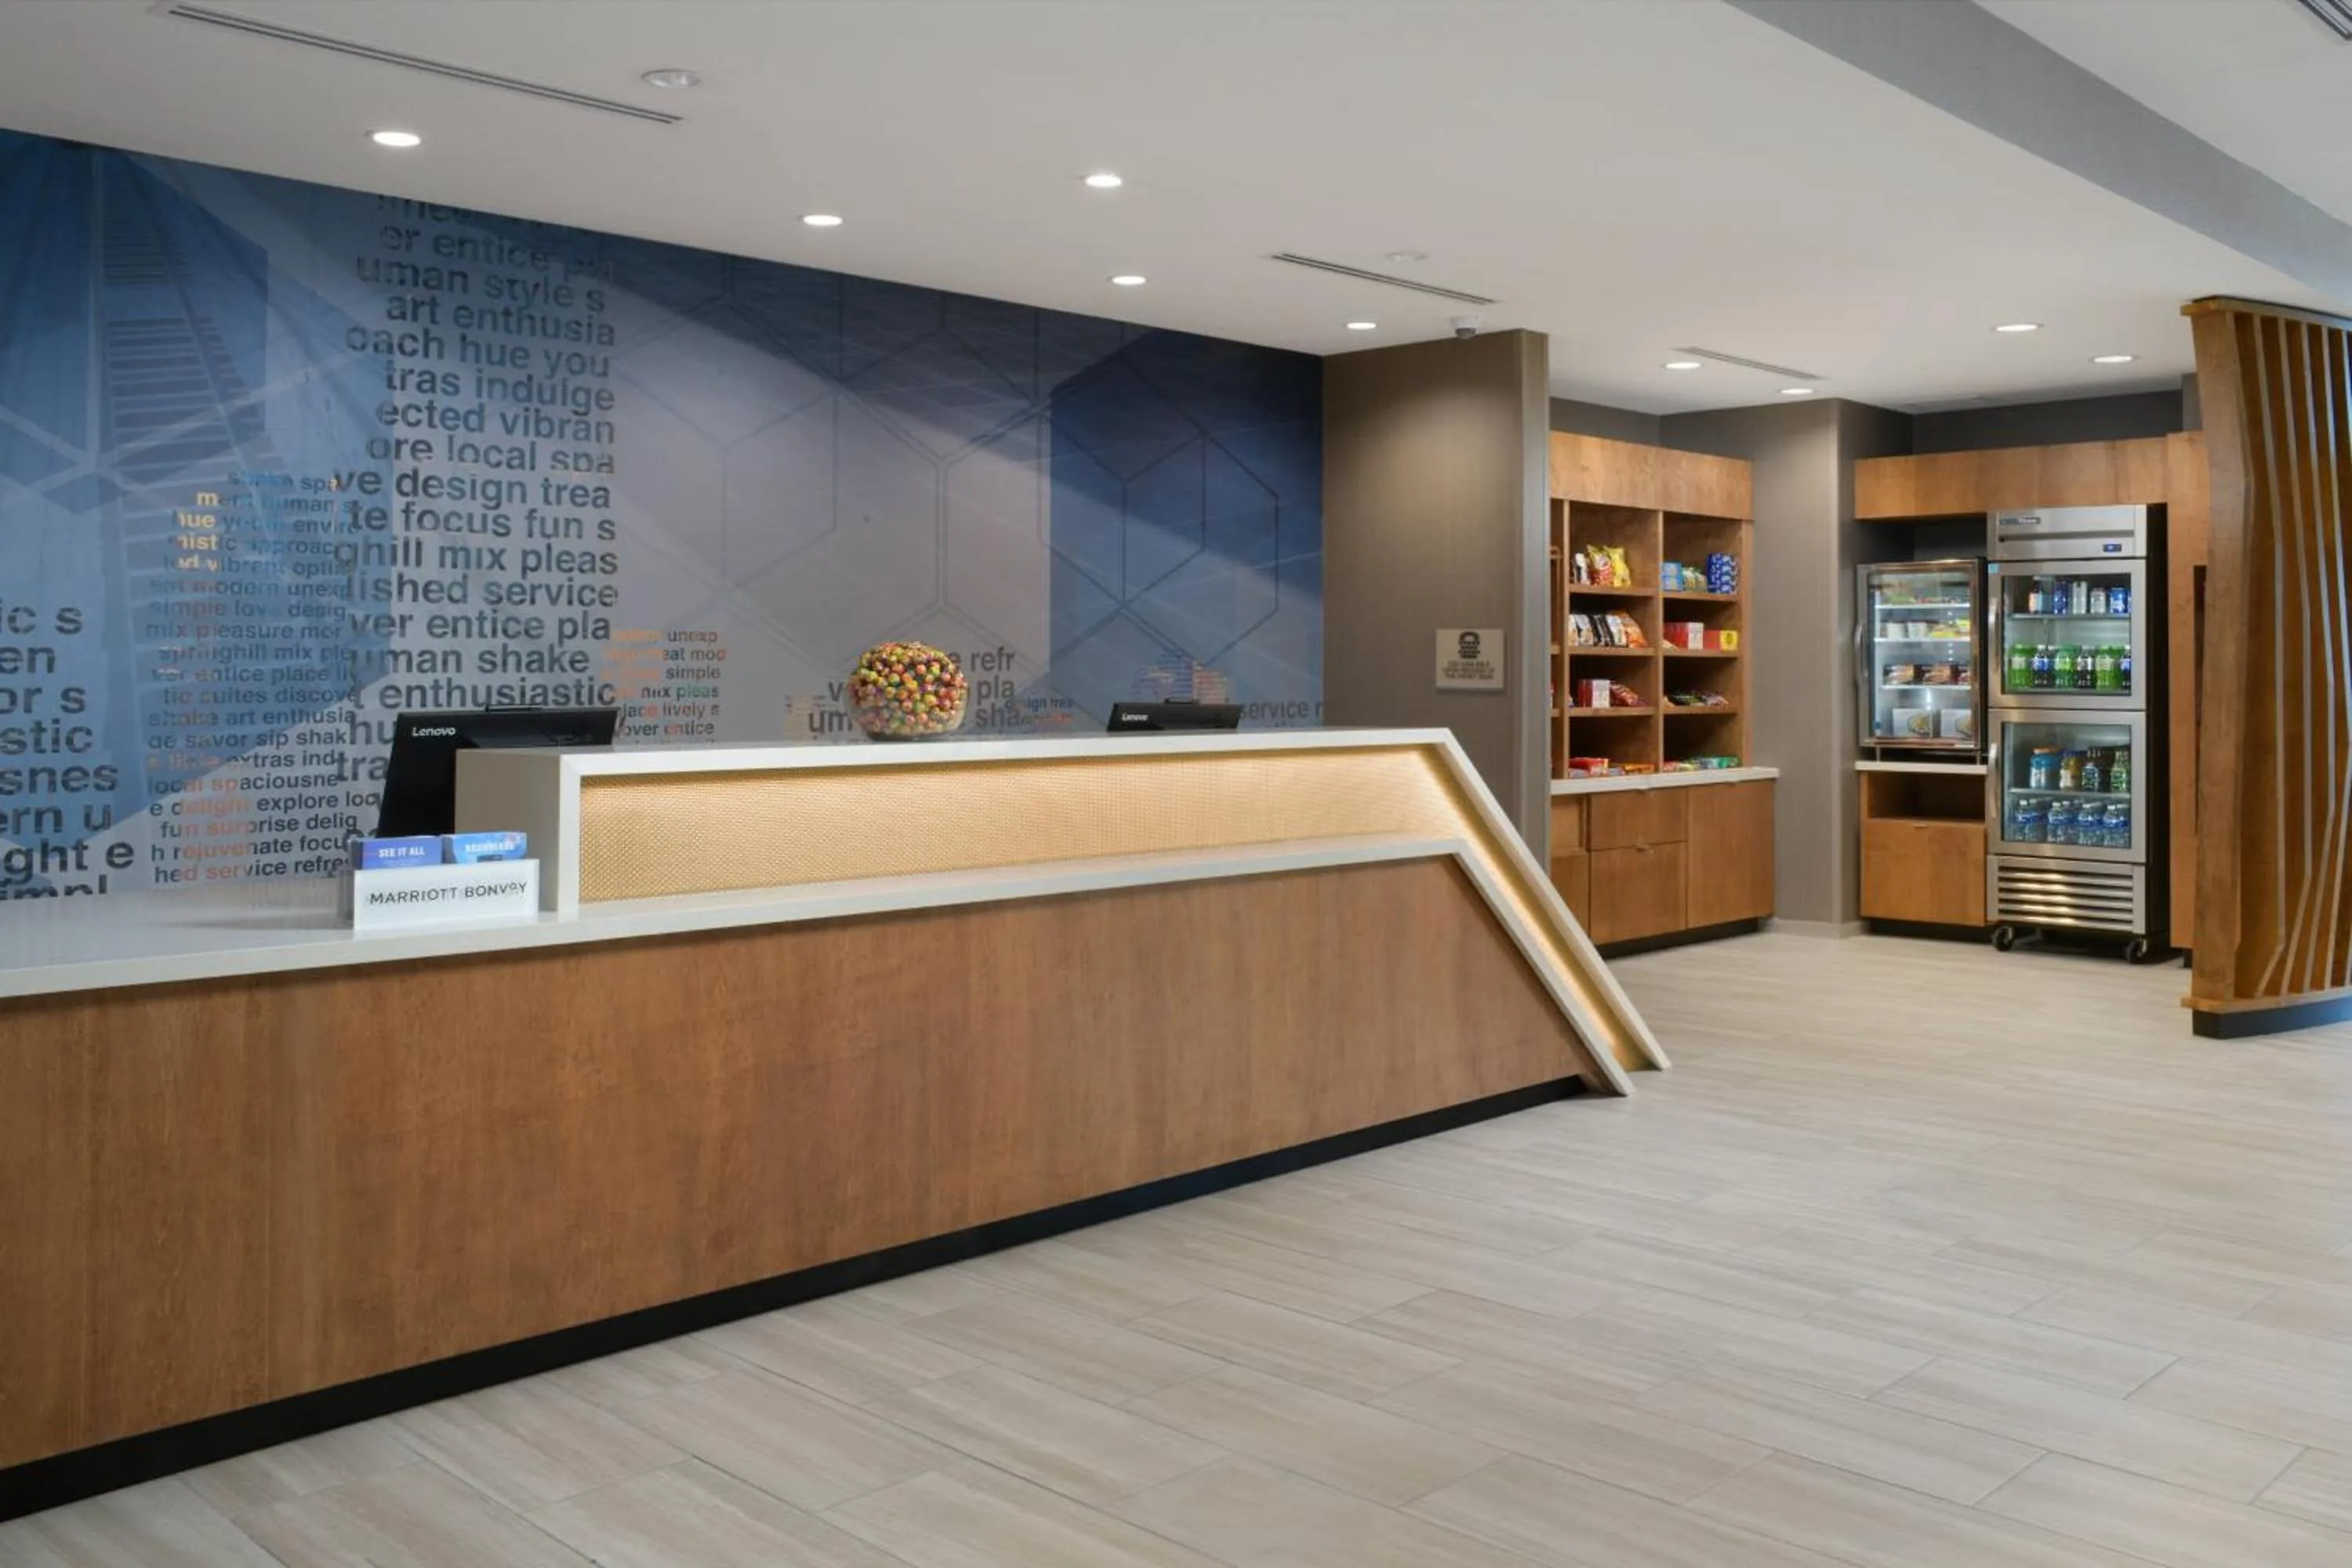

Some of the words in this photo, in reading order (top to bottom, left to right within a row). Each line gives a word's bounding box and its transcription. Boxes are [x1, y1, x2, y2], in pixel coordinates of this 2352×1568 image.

[433, 232, 552, 272] entice
[356, 255, 469, 294] uman
[483, 274, 575, 310] style
[586, 288, 607, 313] s
[387, 294, 440, 325] art
[453, 303, 615, 347] enthusia
[346, 326, 445, 360] oach
[459, 332, 531, 369] hue
[543, 350, 609, 379] you
[385, 359, 461, 397] tras
[475, 369, 615, 416] indulge
[376, 397, 486, 433] ected
[499, 406, 615, 444] vibran
[367, 437, 434, 461] ore
[447, 434, 537, 471] local
[550, 449, 615, 474] spa
[395, 467, 528, 510] design
[539, 477, 611, 509] trea
[401, 501, 512, 538] focus
[524, 509, 583, 539] fun
[597, 517, 616, 541] s
[437, 544, 507, 571] mix
[521, 543, 619, 580] pleas
[481, 576, 619, 608] service
[56, 606, 83, 635] s
[426, 608, 545, 641] entice
[557, 610, 612, 648] pla
[476, 643, 590, 675] shake
[970, 646, 1016, 673] refr
[60, 686, 87, 714] s
[379, 677, 616, 710] enthusiastic
[976, 674, 1015, 706] pla
[0, 718, 93, 754] stic
[256, 728, 289, 749] sip
[412, 727, 457, 738] Lenovo
[336, 751, 391, 782] tra
[83, 803, 112, 832] u
[149, 803, 164, 817] e
[256, 791, 339, 815] explore
[2, 838, 89, 886] ght
[105, 840, 135, 869] e
[378, 848, 396, 858] SEE
[397, 847, 408, 858] IT
[408, 845, 426, 856] ALL
[369, 886, 458, 905] MARRIOTT
